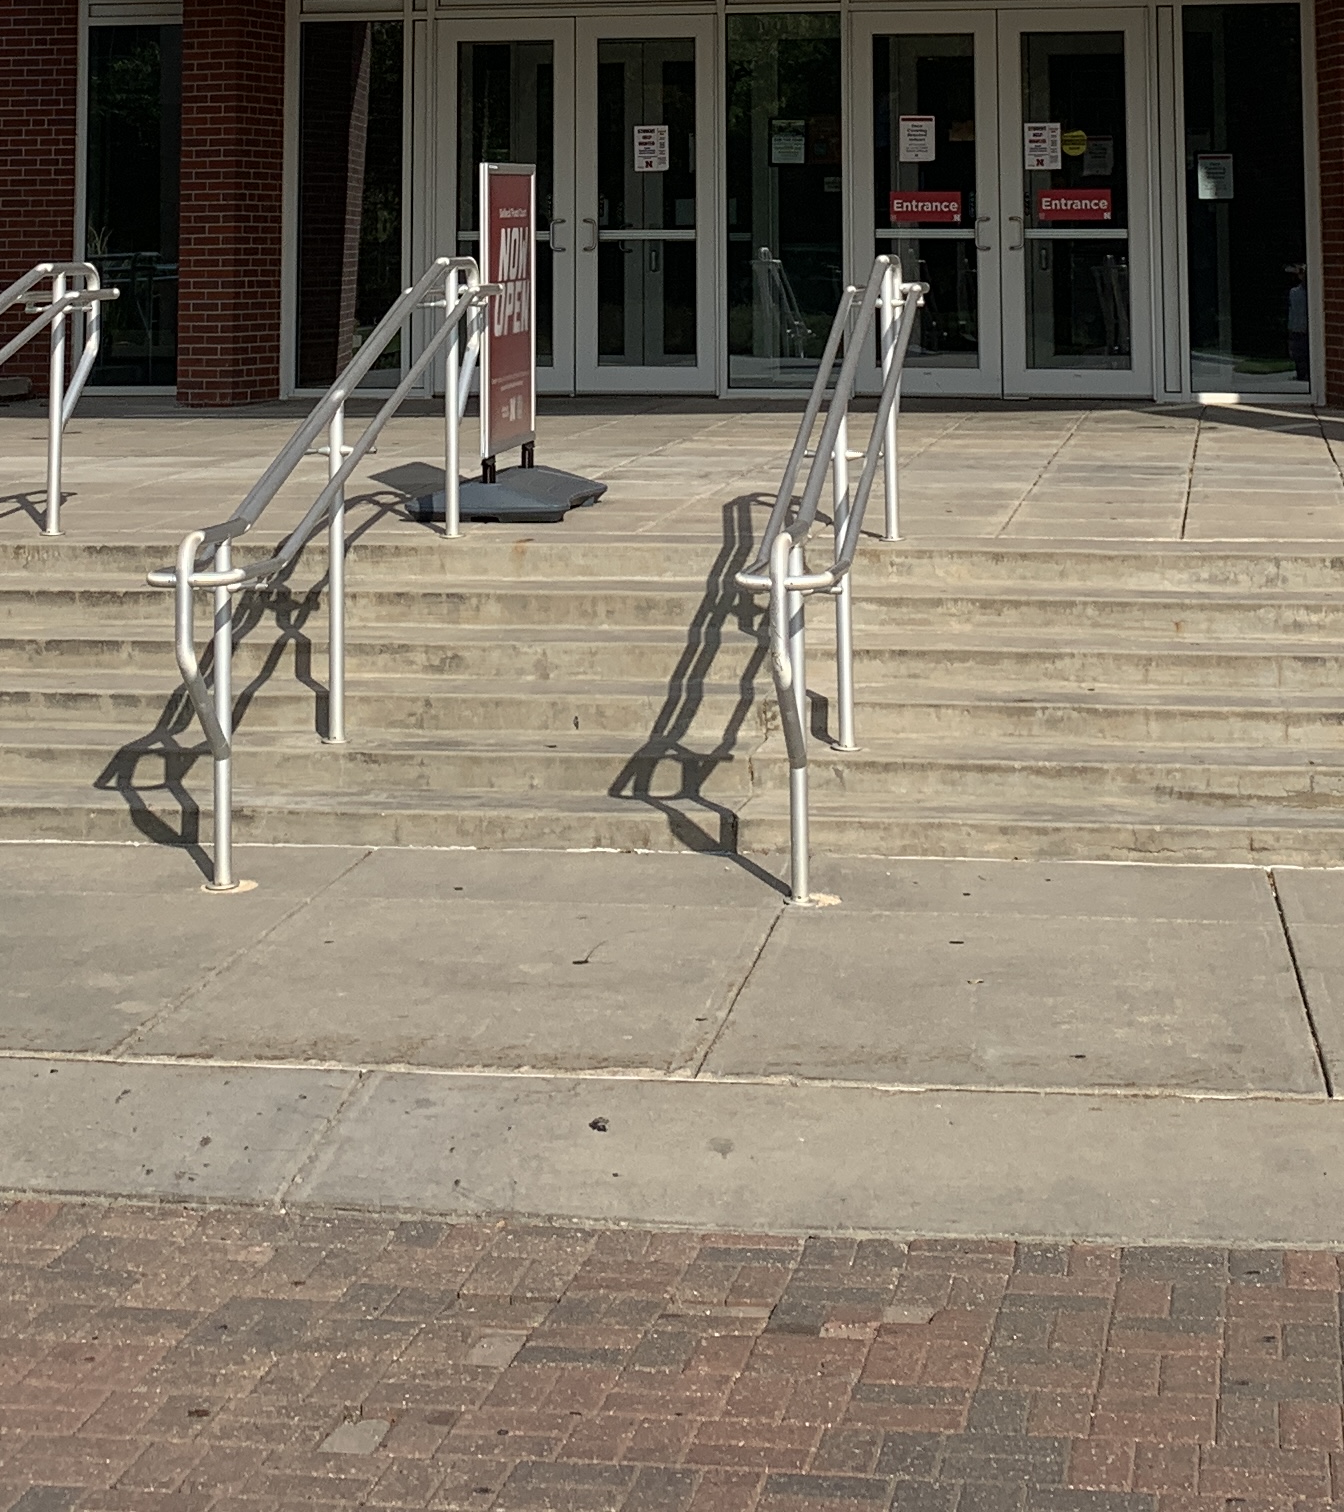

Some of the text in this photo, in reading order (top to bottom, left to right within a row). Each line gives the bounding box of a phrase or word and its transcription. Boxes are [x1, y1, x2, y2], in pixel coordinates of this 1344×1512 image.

[893, 199, 959, 212] Entrance
[1042, 197, 1108, 210] Entrance
[498, 226, 529, 282] NOW
[494, 279, 531, 338] OPEN
